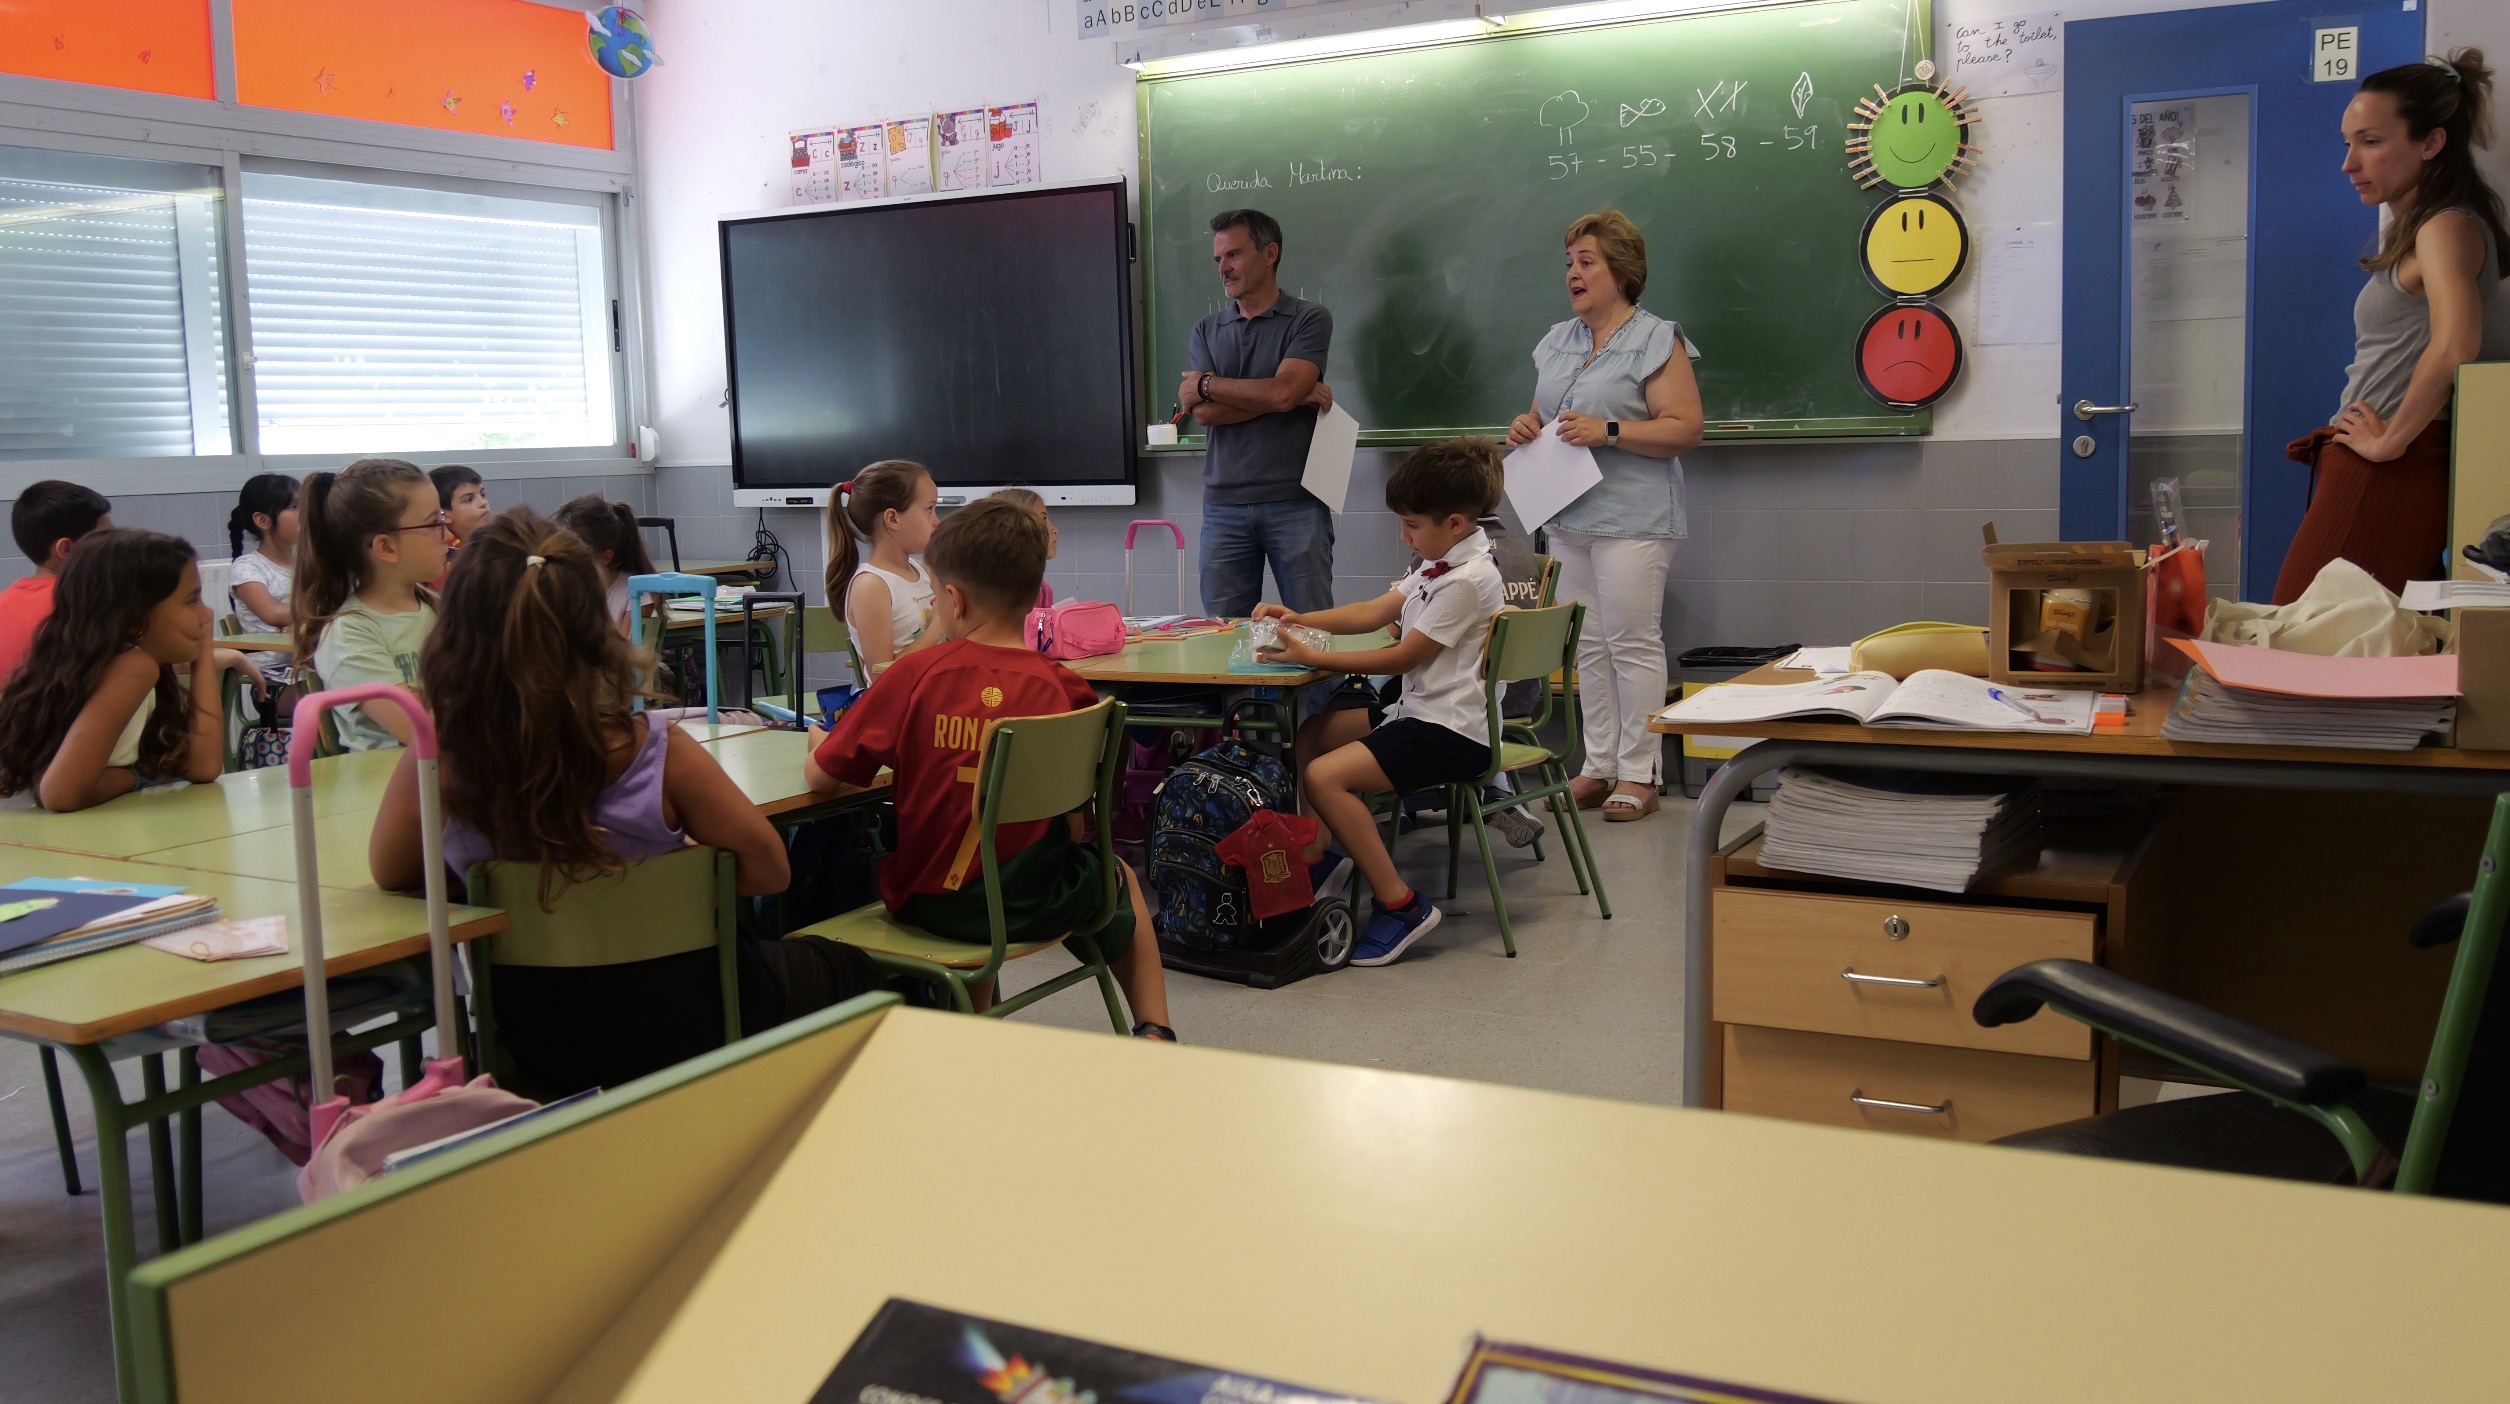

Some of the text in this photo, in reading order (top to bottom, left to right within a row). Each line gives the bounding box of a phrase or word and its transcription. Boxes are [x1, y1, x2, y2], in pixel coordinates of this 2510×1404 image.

[1994, 21, 2005, 30] I
[2013, 20, 2028, 35] go
[1957, 26, 2057, 53] to the toilet,
[2321, 32, 2351, 51] PE
[2323, 58, 2348, 76] 19
[2140, 113, 2154, 124] DEL
[991, 142, 1005, 152] jugo
[1548, 152, 1583, 180] 57
[1622, 145, 1657, 169] 55
[1700, 133, 1736, 161] 58
[1783, 124, 1818, 150] 59
[1206, 160, 1362, 193] Querida Martina:
